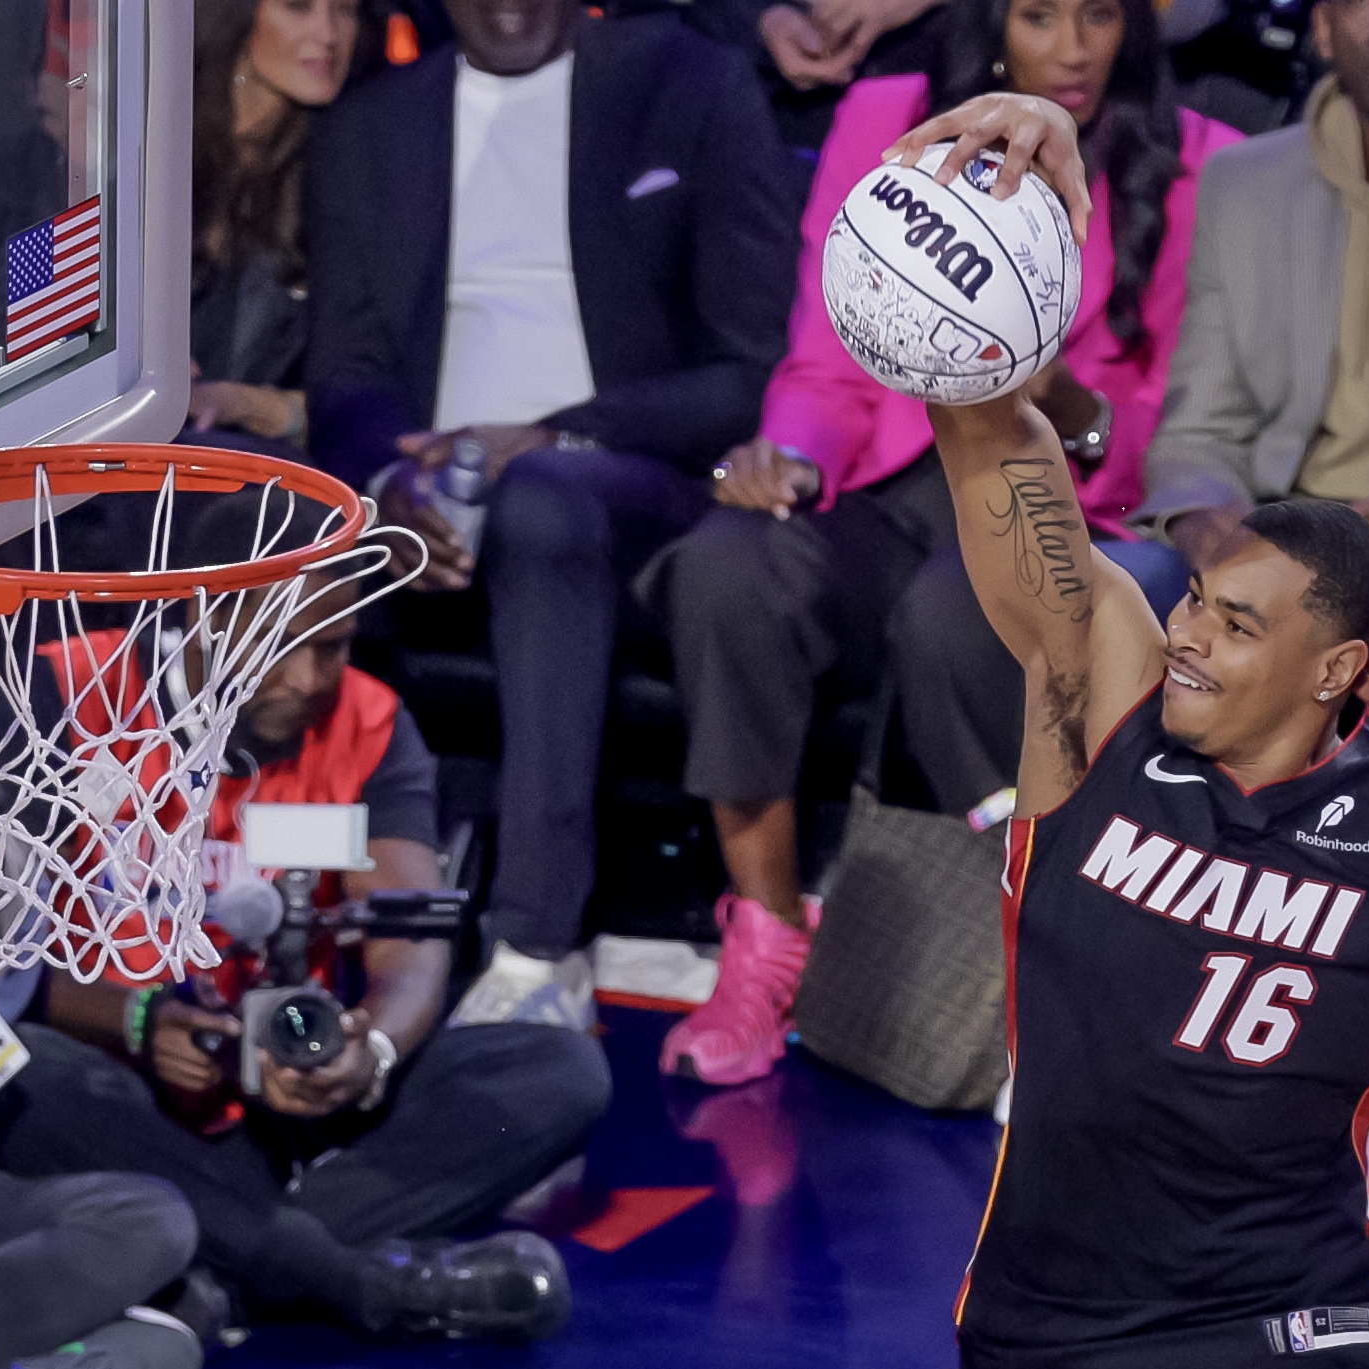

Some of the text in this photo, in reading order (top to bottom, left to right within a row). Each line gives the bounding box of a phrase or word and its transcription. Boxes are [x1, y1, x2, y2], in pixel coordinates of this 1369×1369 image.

[868, 172, 995, 305] Wilson
[1078, 814, 1366, 959] MIAMI
[1172, 952, 1318, 1067] 16
